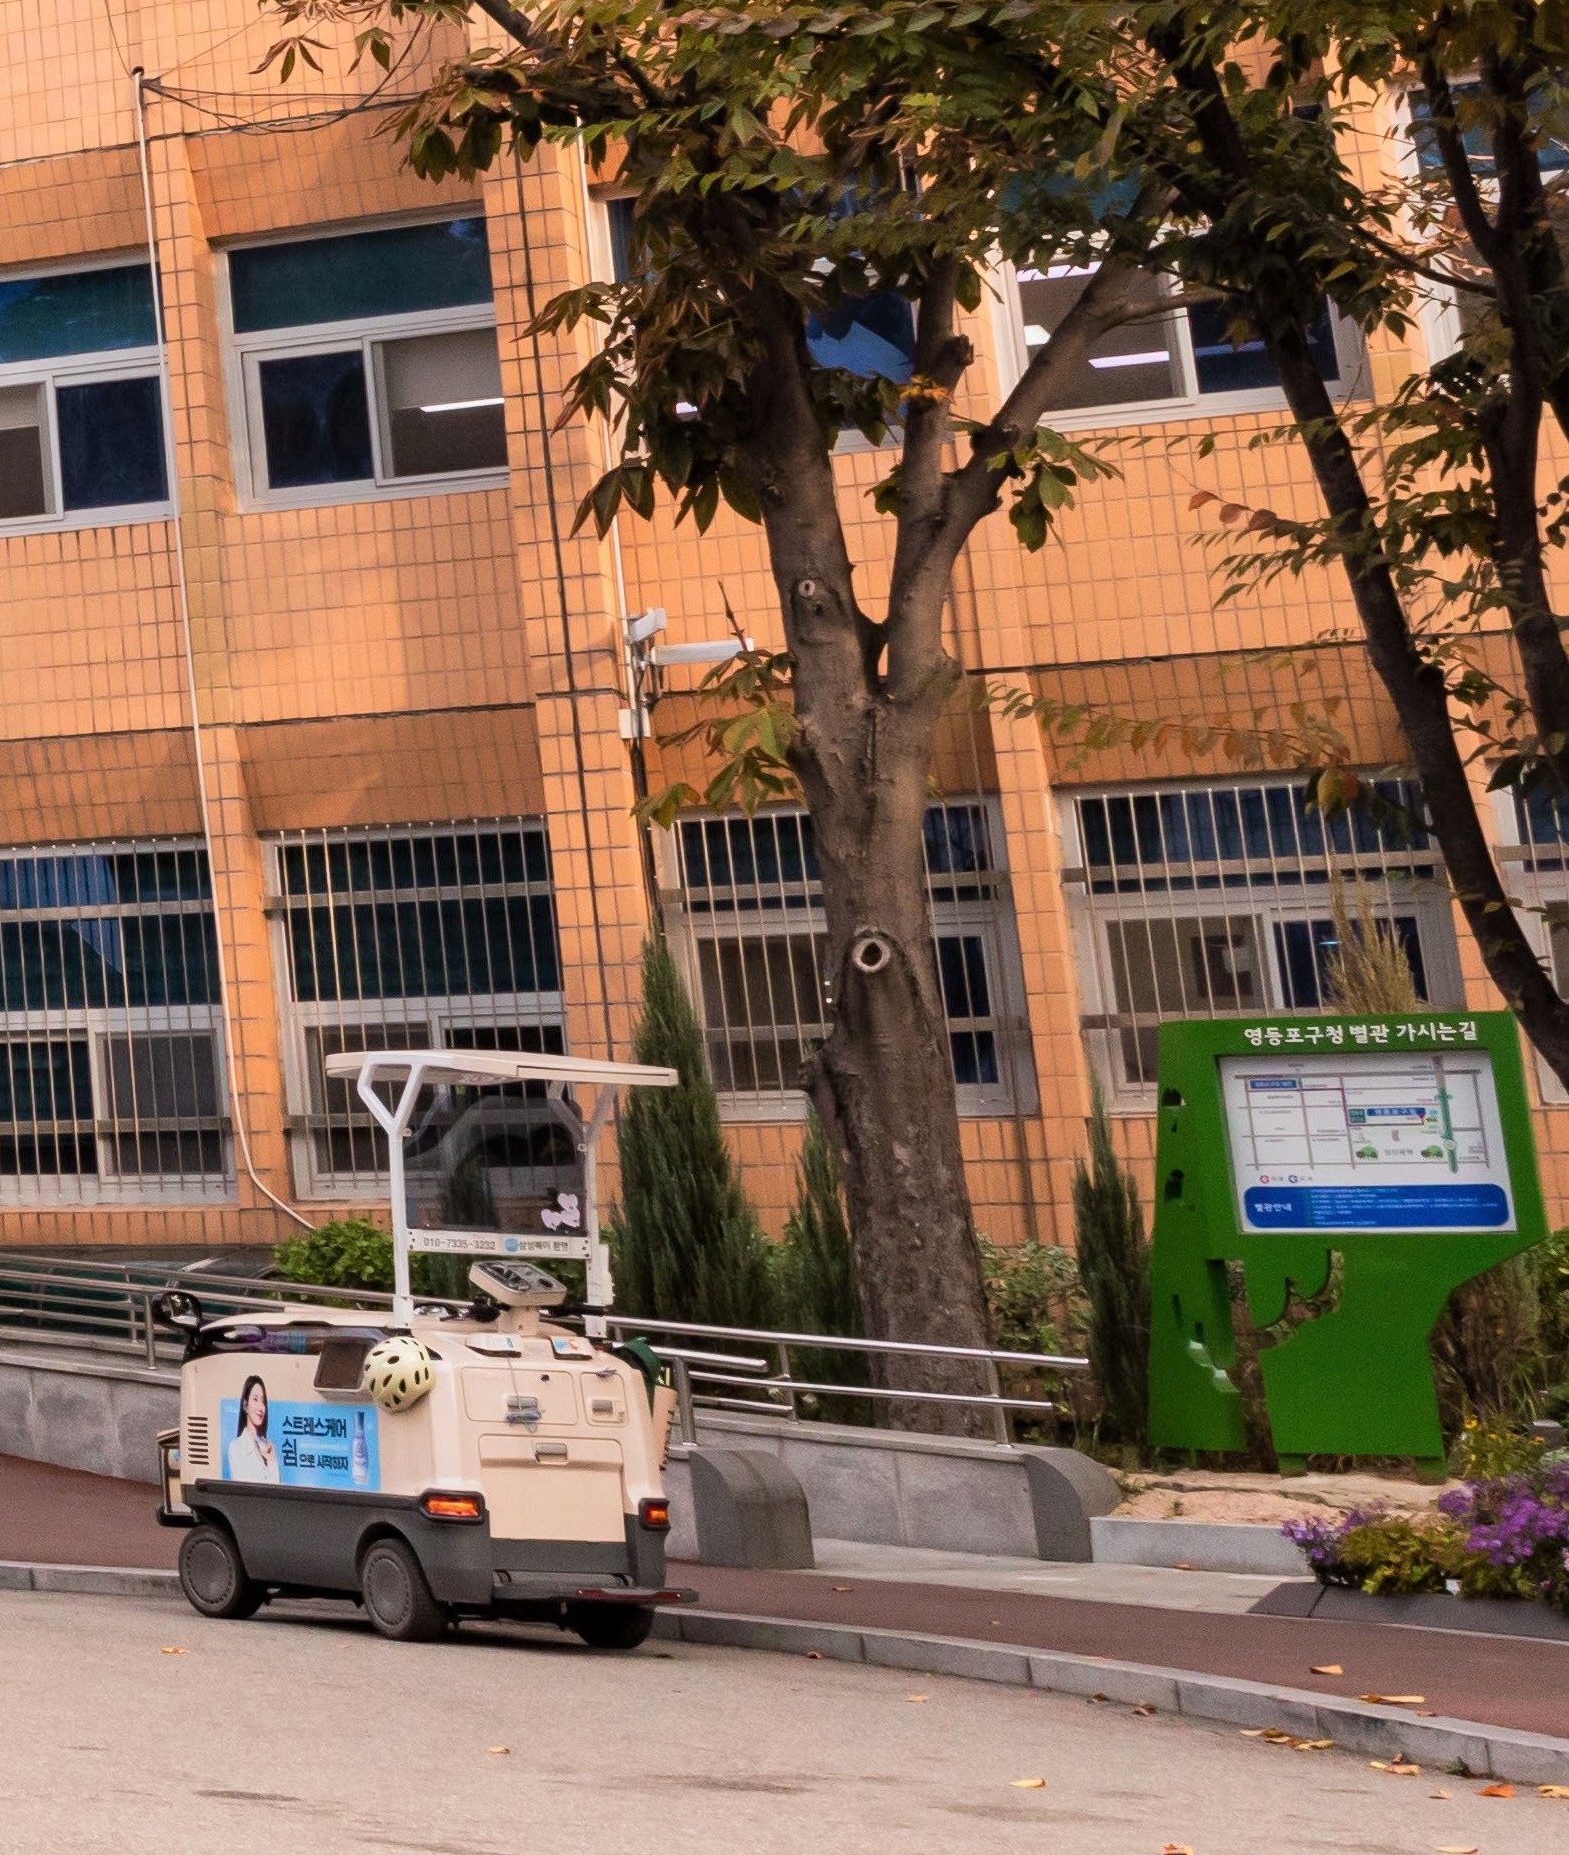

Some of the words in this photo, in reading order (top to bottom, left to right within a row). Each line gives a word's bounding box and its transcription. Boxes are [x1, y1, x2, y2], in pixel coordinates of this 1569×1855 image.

[1244, 1027, 1344, 1046] 영등포구청
[1349, 1024, 1390, 1044] 별관
[1396, 1021, 1478, 1042] 가시는길
[282, 1416, 347, 1438] 스트레스케어
